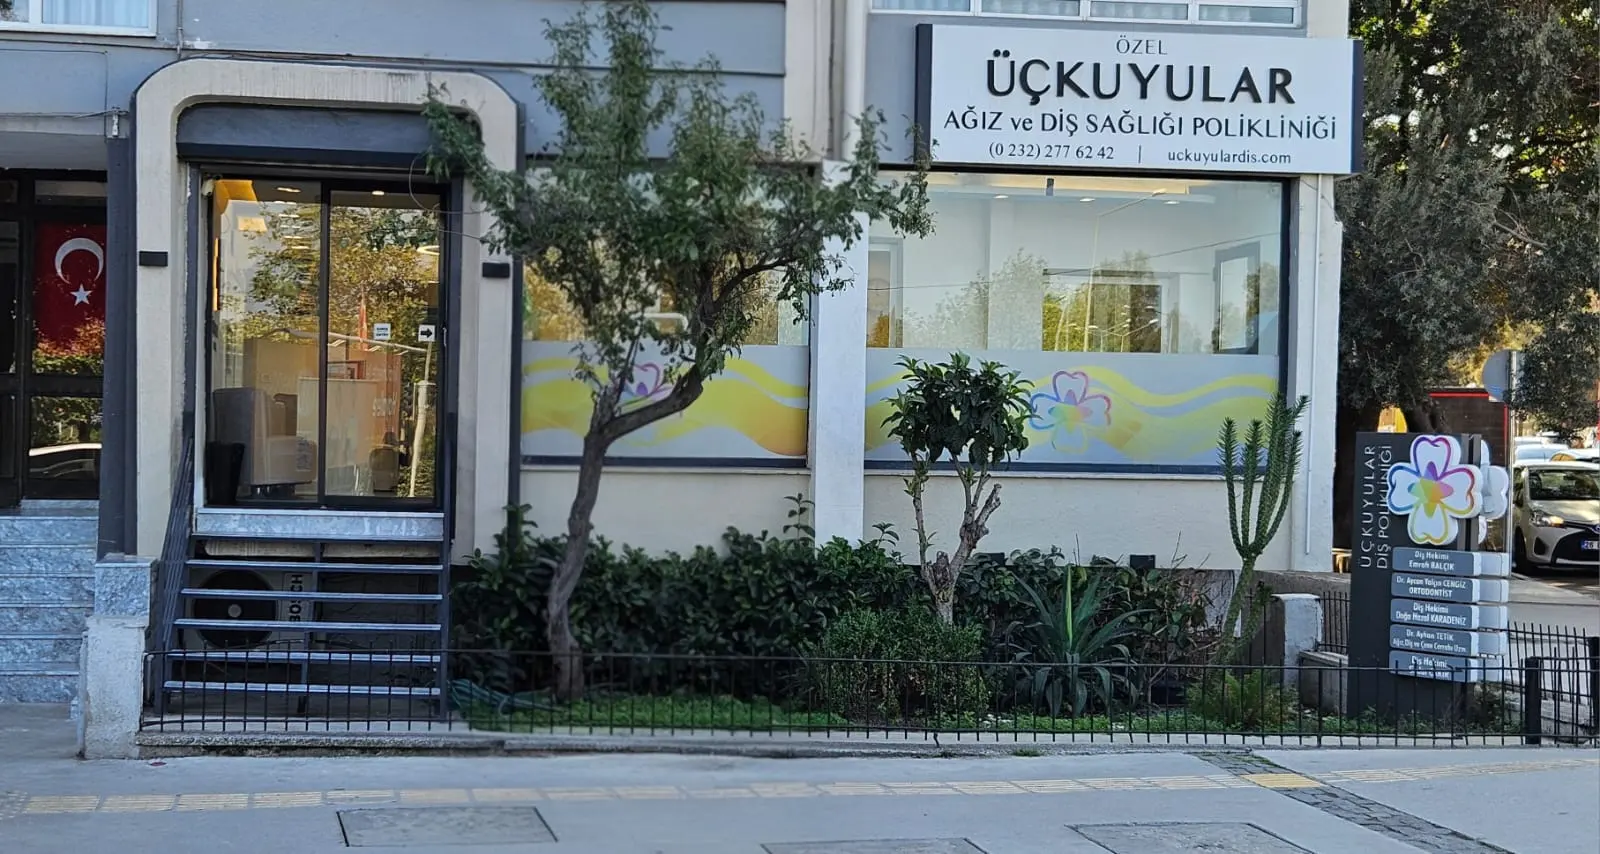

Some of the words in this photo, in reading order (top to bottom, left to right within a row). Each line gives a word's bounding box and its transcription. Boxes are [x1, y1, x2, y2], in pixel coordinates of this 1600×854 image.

[1116, 35, 1168, 55] ÖZEL
[986, 49, 1296, 106] ÜÇKUYULAR
[943, 105, 1004, 131] AĞIZ
[1010, 116, 1033, 132] ve
[1041, 108, 1078, 137] DİŞ
[1086, 109, 1183, 136] SAĞLIĞI
[1192, 113, 1336, 140] POLİKLİNİĞİ
[988, 142, 1004, 159] (0
[1008, 143, 1041, 160] 232)
[1044, 144, 1071, 159] 277
[1075, 145, 1094, 160] 62
[1097, 146, 1115, 160] 42
[1168, 148, 1292, 165] uckuyulardis.com
[1357, 446, 1376, 568] ÜÇKUYULAR
[1375, 543, 1392, 569] DİŞ
[1414, 550, 1425, 560] Diş
[1425, 551, 1449, 561] Hekimi
[1408, 559, 1430, 569] Emrah
[1430, 561, 1455, 572] BALÇIK
[1396, 575, 1405, 584] Dr.
[1442, 579, 1466, 589] CENGİZ
[1408, 586, 1453, 598] ORTODONTİST
[1413, 602, 1424, 613] Diş
[1425, 603, 1449, 614] Hekimi
[1430, 614, 1467, 626] KARADENİZ
[1406, 628, 1414, 638] Dr.
[1436, 632, 1454, 641] TETİK
